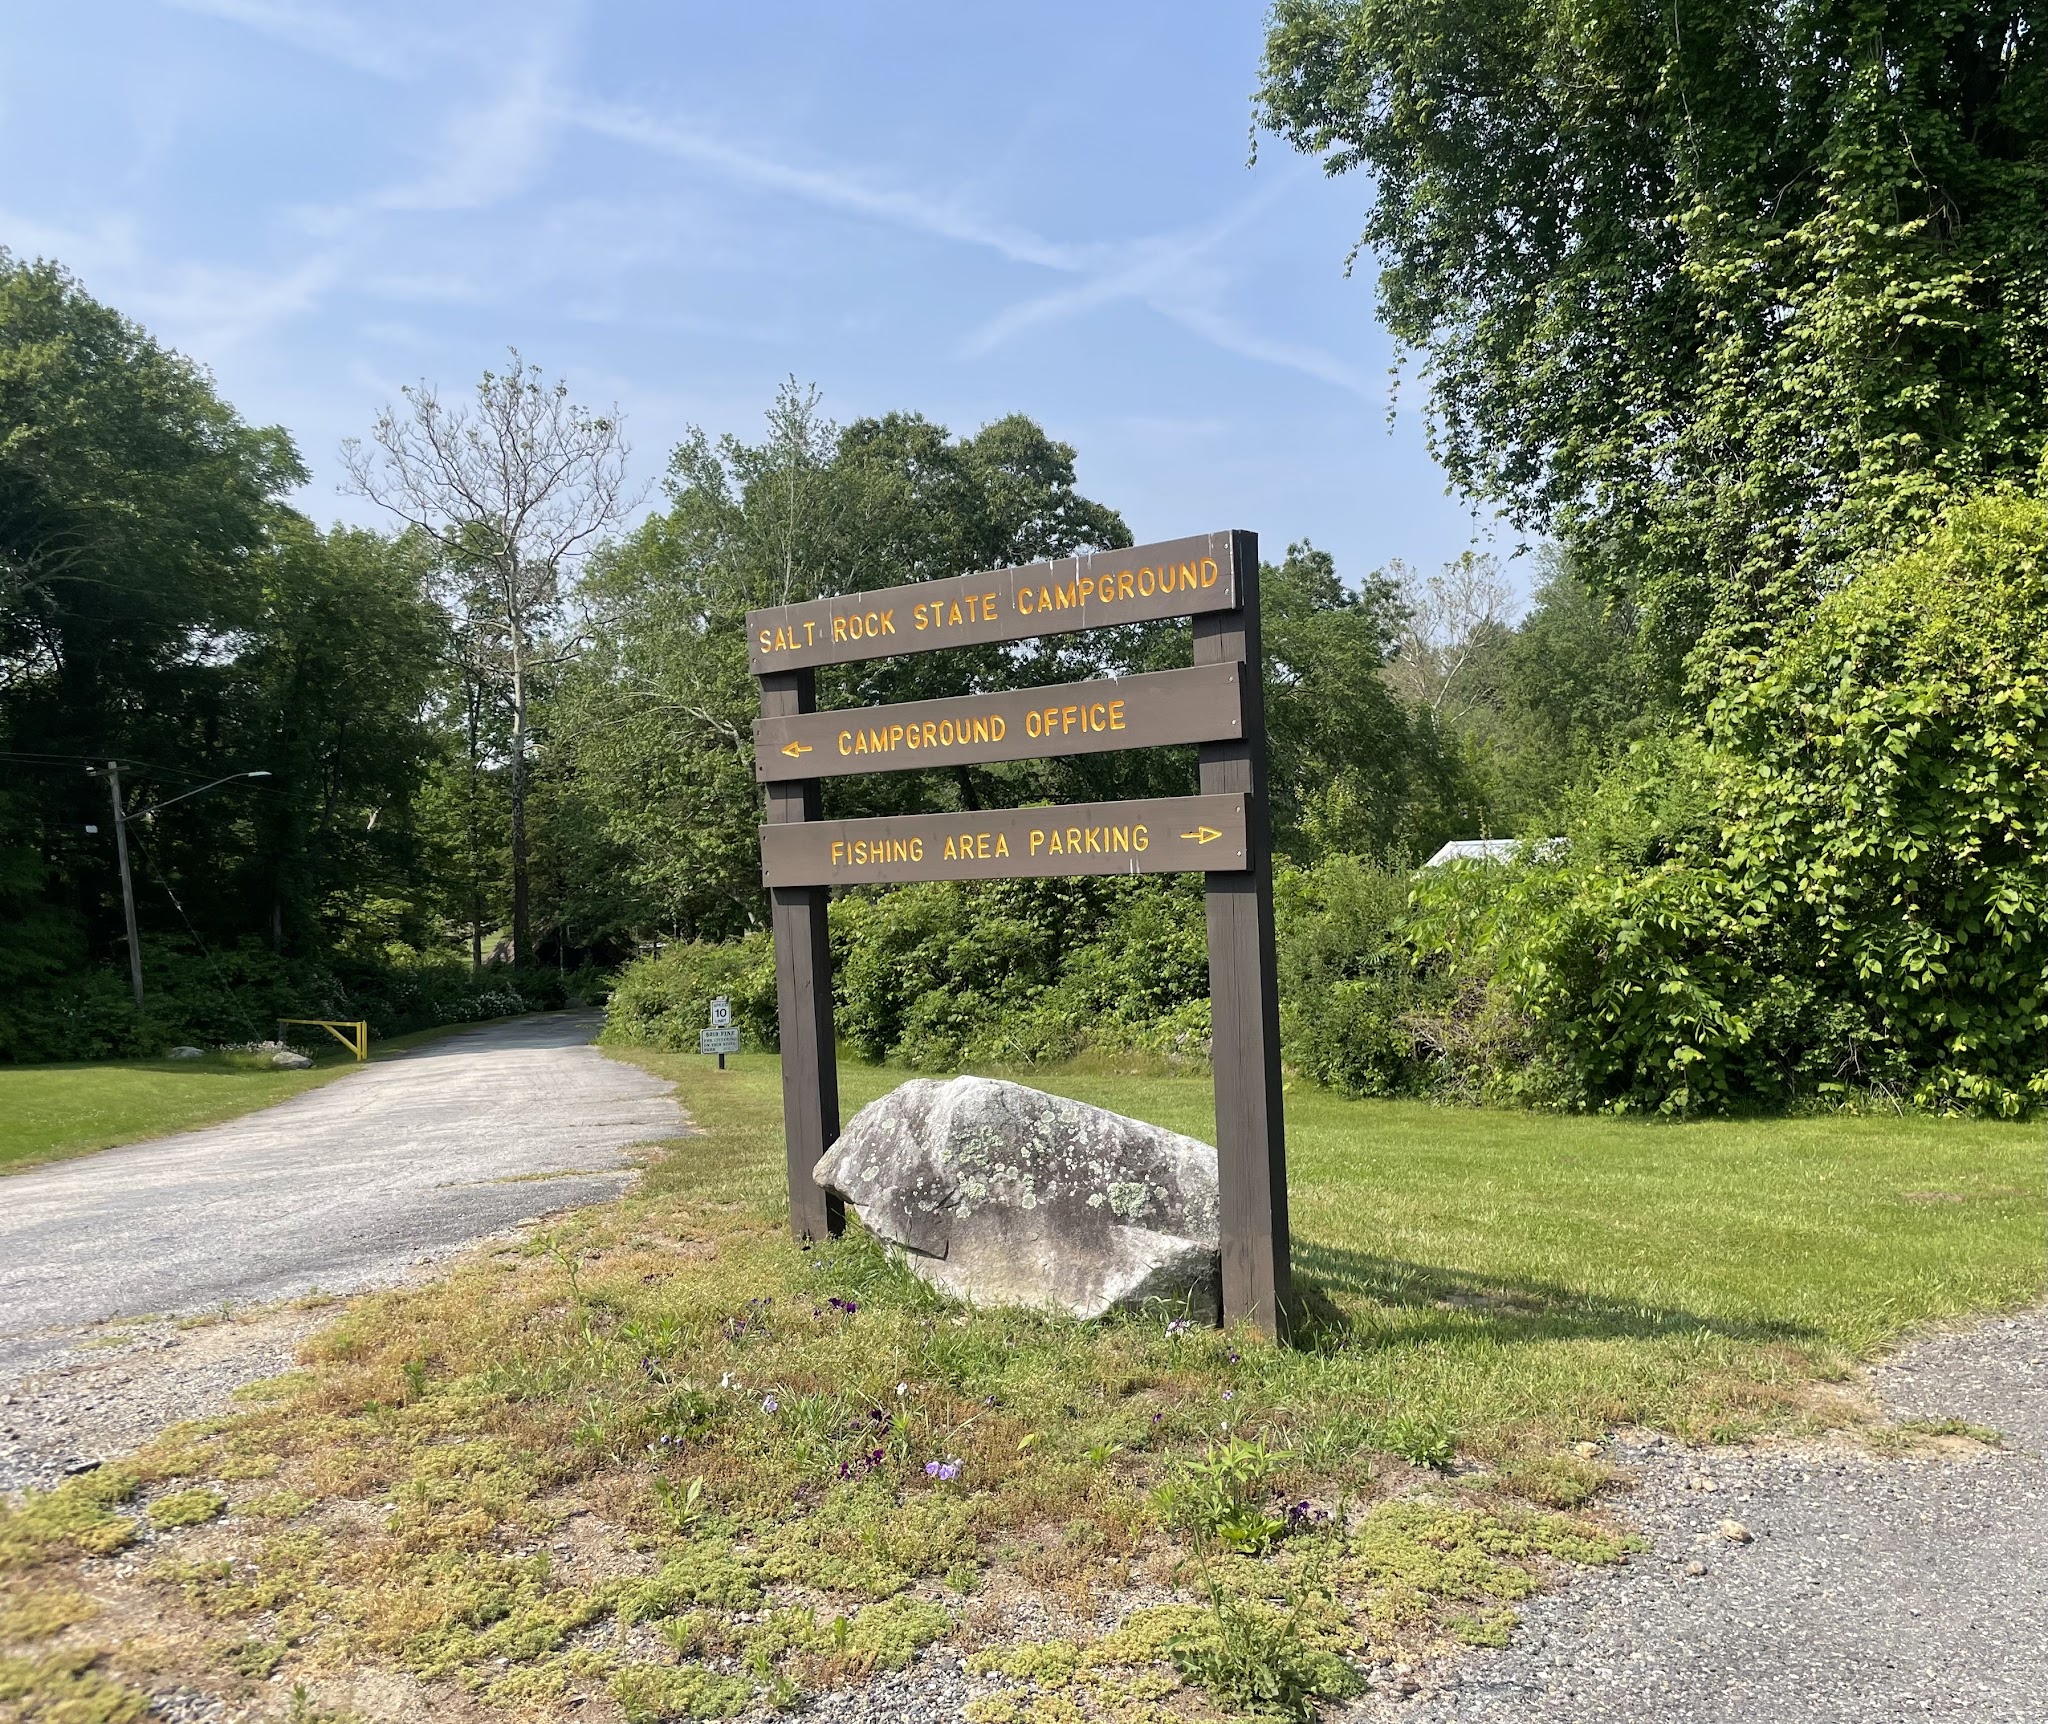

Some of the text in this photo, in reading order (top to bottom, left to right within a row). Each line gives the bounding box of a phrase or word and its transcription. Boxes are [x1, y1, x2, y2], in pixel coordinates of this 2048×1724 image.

[759, 556, 1219, 654] SALT ROCK STATE CAMPGROUND
[838, 700, 1126, 756] CAMPGROUND OFFICE
[831, 823, 1149, 866] FISHING AREA PARKING
[715, 1008, 727, 1018] 10
